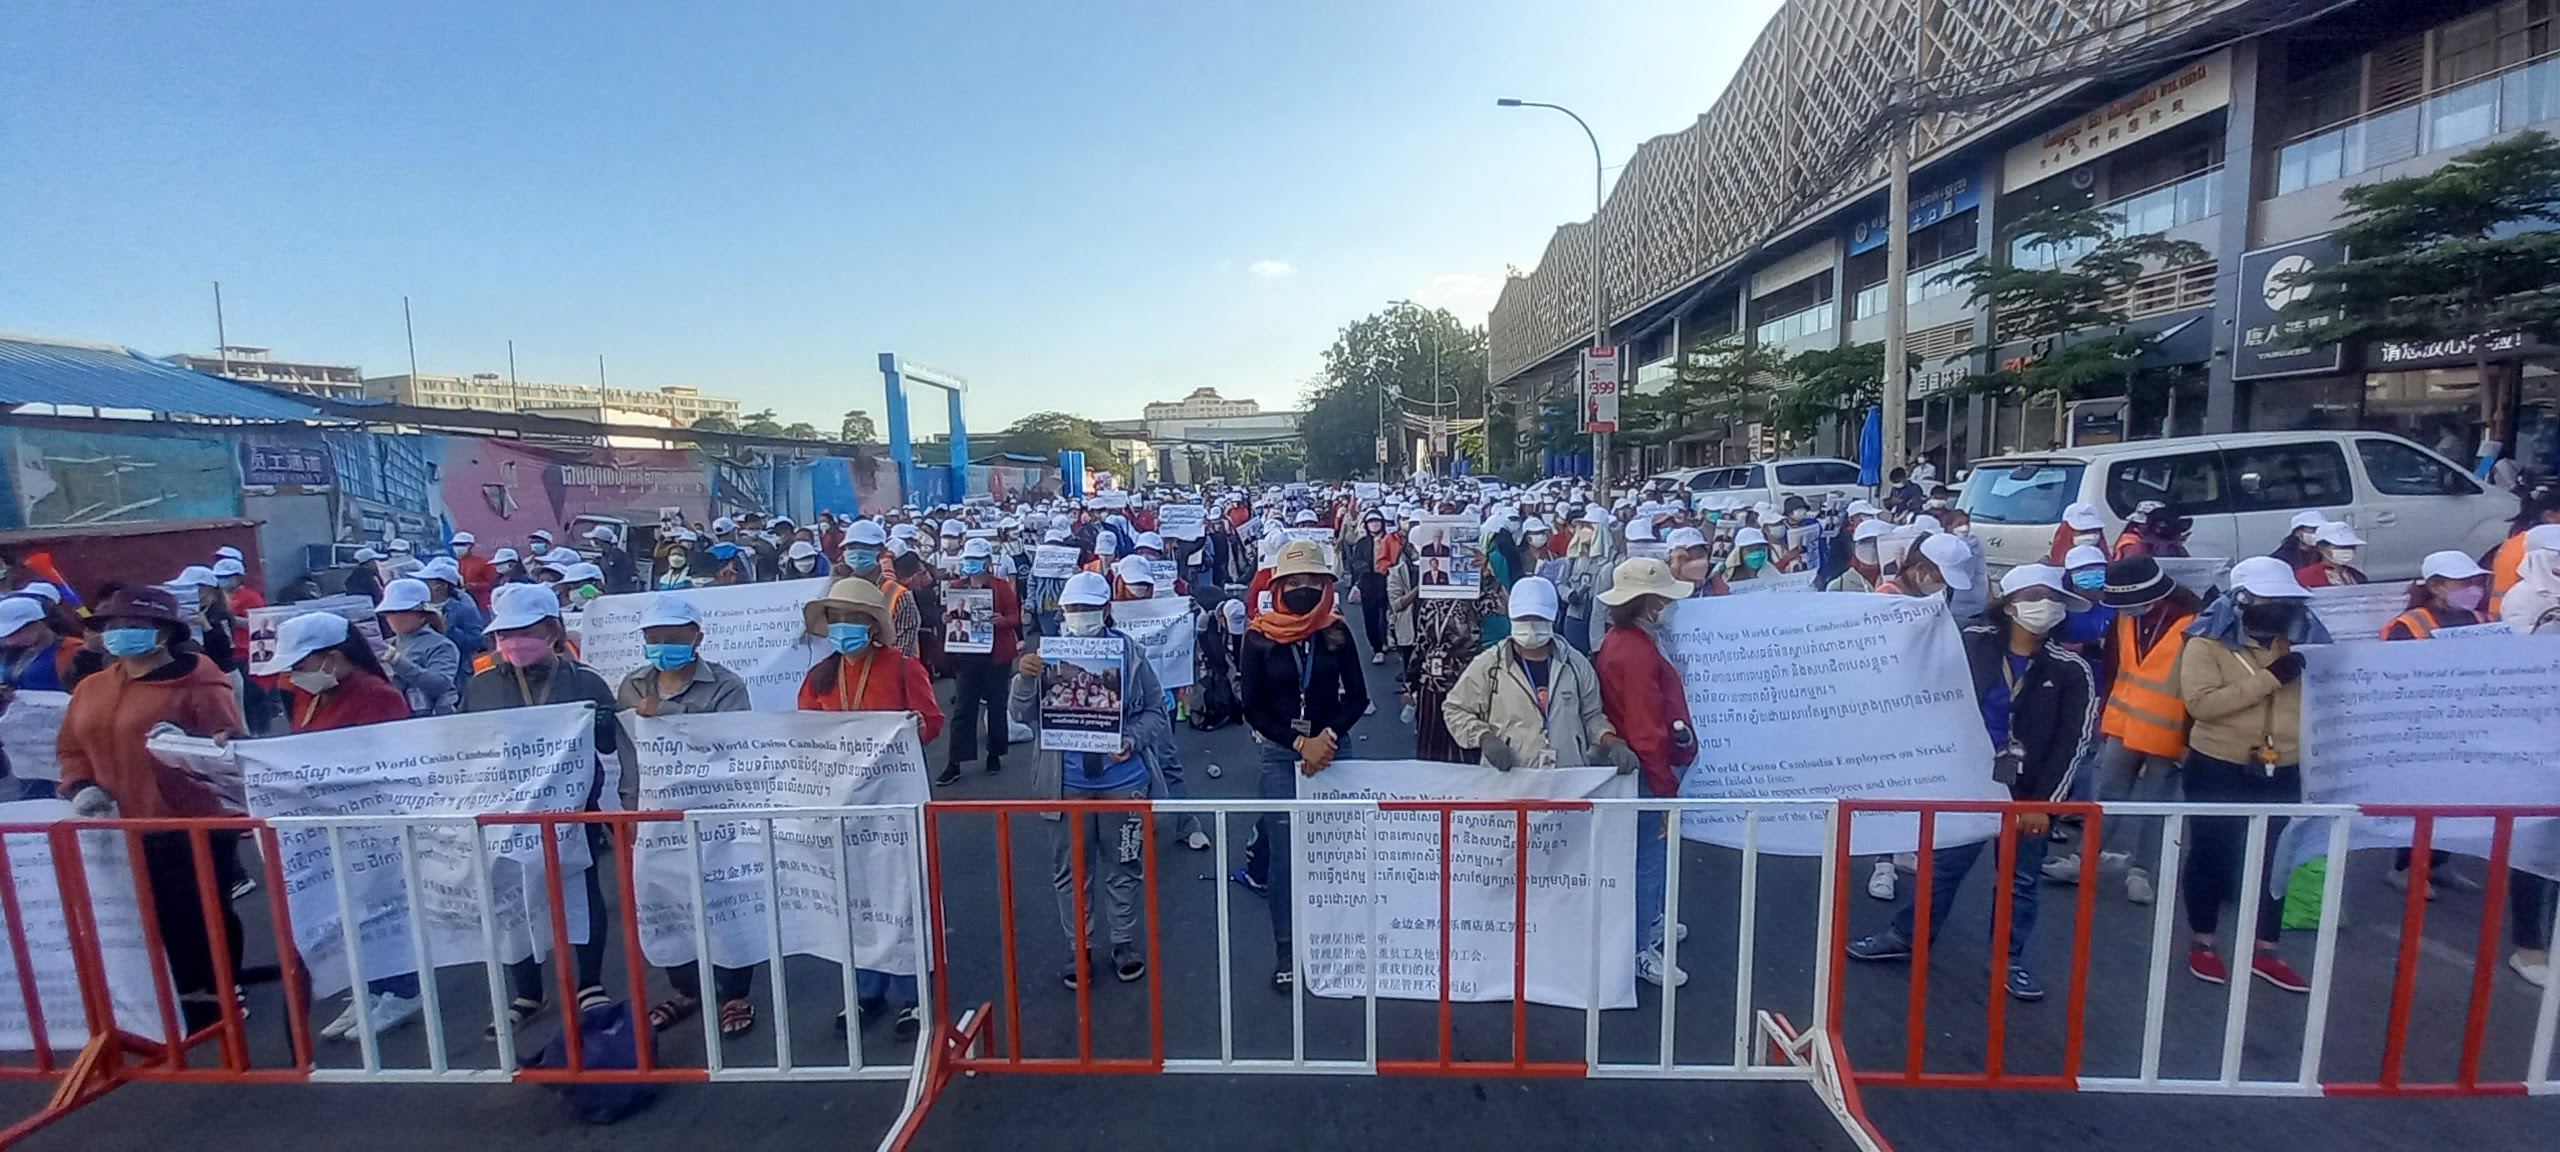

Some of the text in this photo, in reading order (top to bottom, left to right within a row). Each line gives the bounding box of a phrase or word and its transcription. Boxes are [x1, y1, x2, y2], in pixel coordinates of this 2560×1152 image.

[1806, 619, 1860, 633] Cambodia
[713, 739, 749, 752] World
[751, 739, 787, 749] Casino
[788, 738, 837, 751] Cambodia
[336, 765, 371, 776] Naga
[375, 756, 417, 771] World
[420, 752, 455, 765] Casino
[456, 749, 501, 761] Cambodia
[1705, 760, 1740, 774] World
[1741, 760, 1777, 773] Casino
[1779, 756, 1834, 770] Cambodia
[1836, 750, 1897, 769] Employees
[1898, 749, 1914, 760] on
[1915, 742, 1958, 759] Strike!
[1724, 774, 1753, 786] failed
[1754, 775, 1766, 785] to
[1771, 784, 1807, 799] respect
[1808, 782, 1864, 798] employees
[1865, 777, 1885, 790] and
[1886, 775, 1912, 788] their
[1778, 810, 1790, 822] of
[1792, 809, 1808, 821] the
[1309, 933, 1395, 946] 管理层拒绝听。
